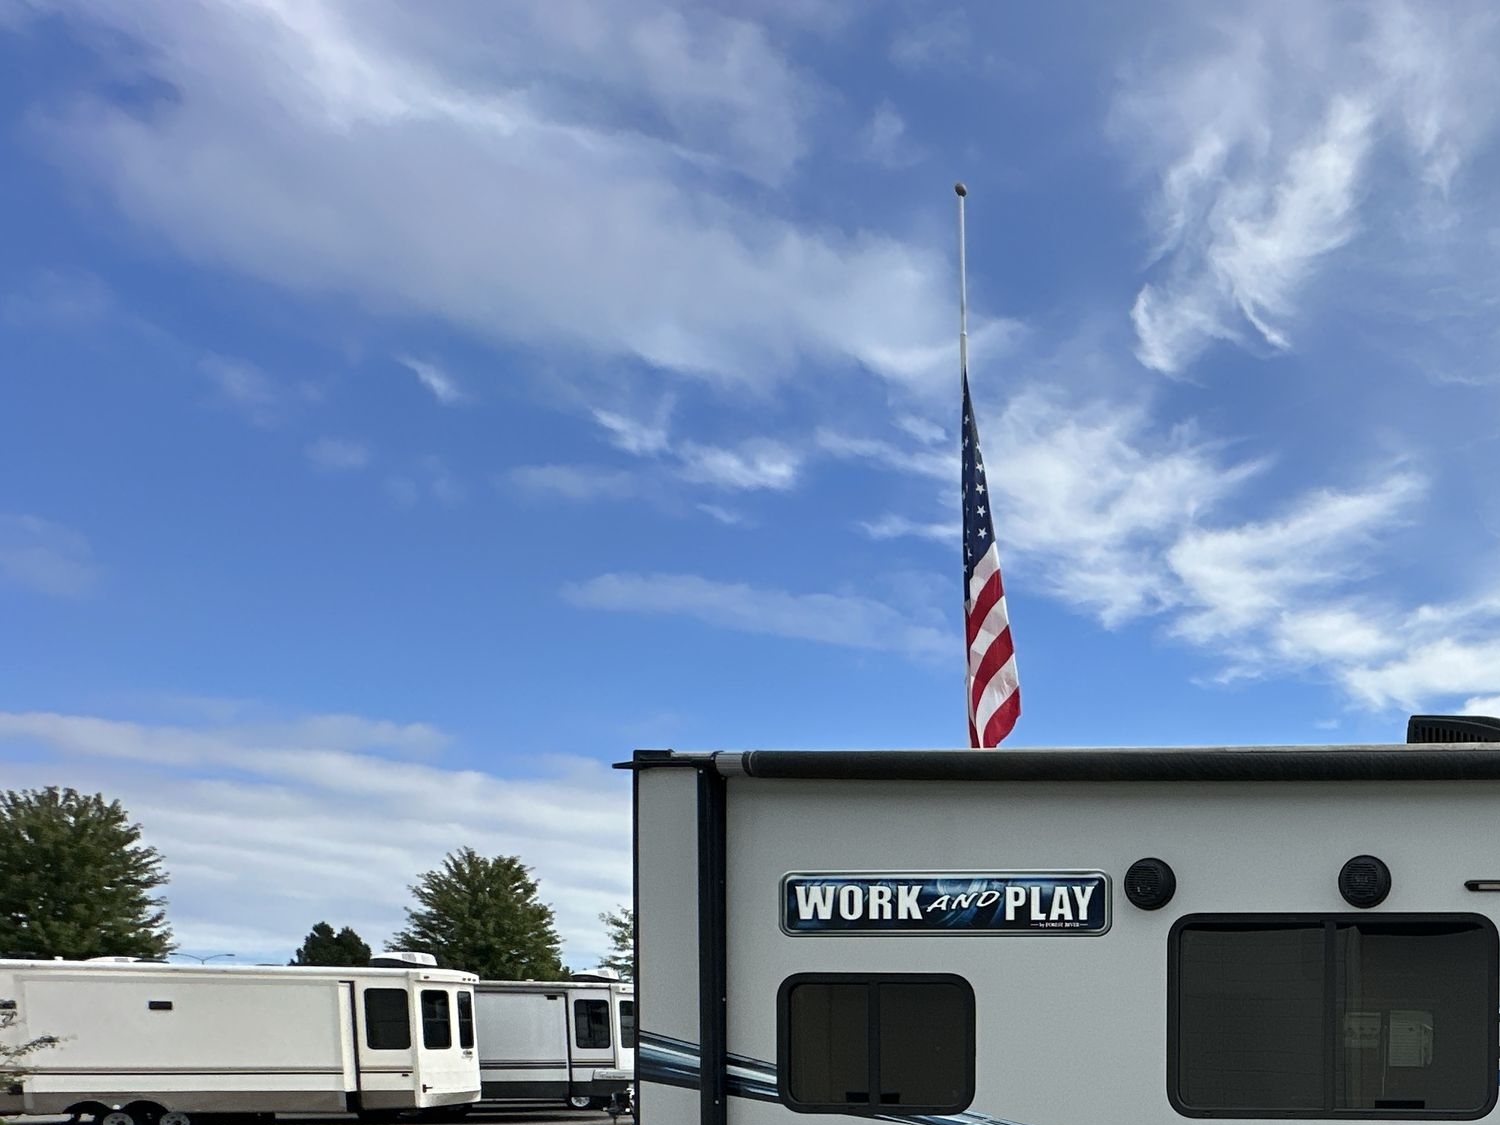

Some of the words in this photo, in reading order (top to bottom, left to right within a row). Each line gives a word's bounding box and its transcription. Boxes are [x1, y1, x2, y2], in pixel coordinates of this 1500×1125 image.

[795, 885, 924, 921] WORK
[926, 889, 1001, 913] AND
[1004, 885, 1096, 921] PLAY
